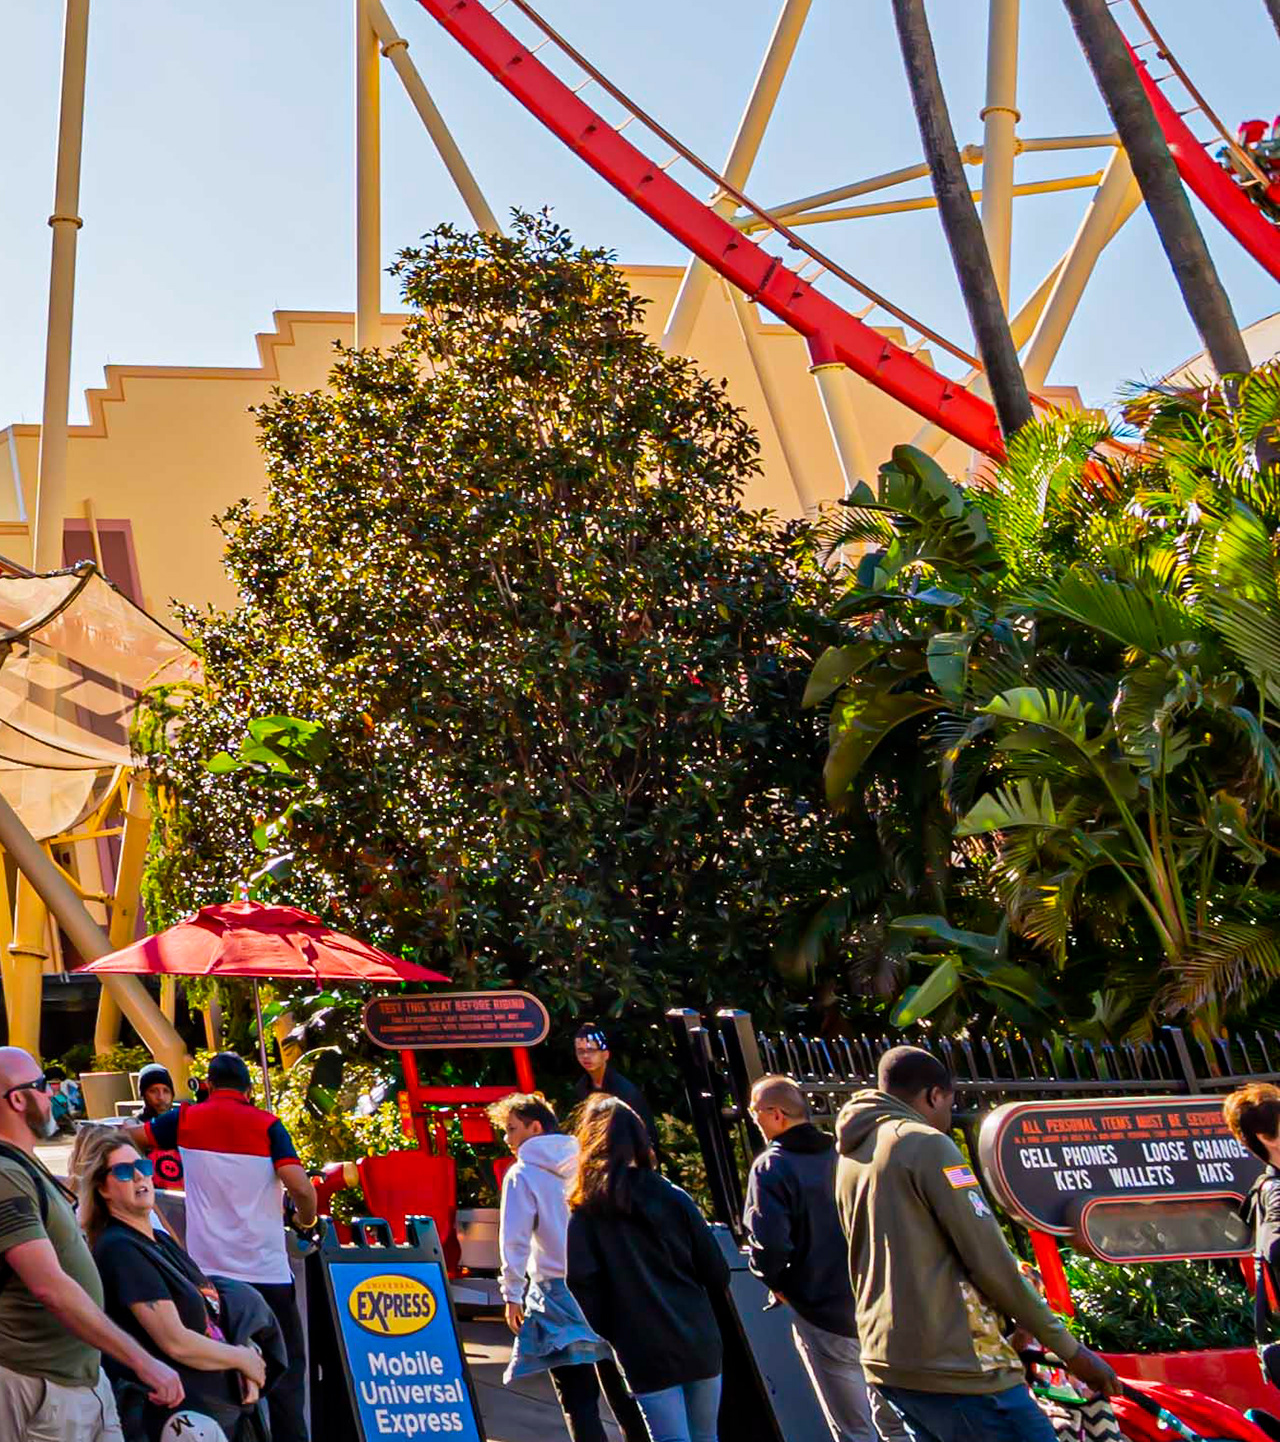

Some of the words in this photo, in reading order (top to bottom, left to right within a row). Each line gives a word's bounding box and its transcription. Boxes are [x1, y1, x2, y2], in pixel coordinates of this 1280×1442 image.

[1022, 1120, 1042, 1134] ALL
[1046, 1117, 1097, 1133] PERSONAL
[1101, 1116, 1133, 1130] ITEMS
[1136, 1115, 1163, 1129] MUST
[1020, 1147, 1057, 1169] CELL
[1062, 1145, 1118, 1166] PHONES
[1142, 1142, 1188, 1163] LOOSE
[1193, 1139, 1248, 1161] CHANGE
[1054, 1169, 1093, 1191] KEYS
[1109, 1166, 1175, 1188] WALLETS
[1197, 1163, 1235, 1183] HATS
[357, 1291, 430, 1331] EXPRESS
[367, 1351, 443, 1376] Mobile
[360, 1378, 463, 1405] Universal
[375, 1409, 463, 1438] Express
